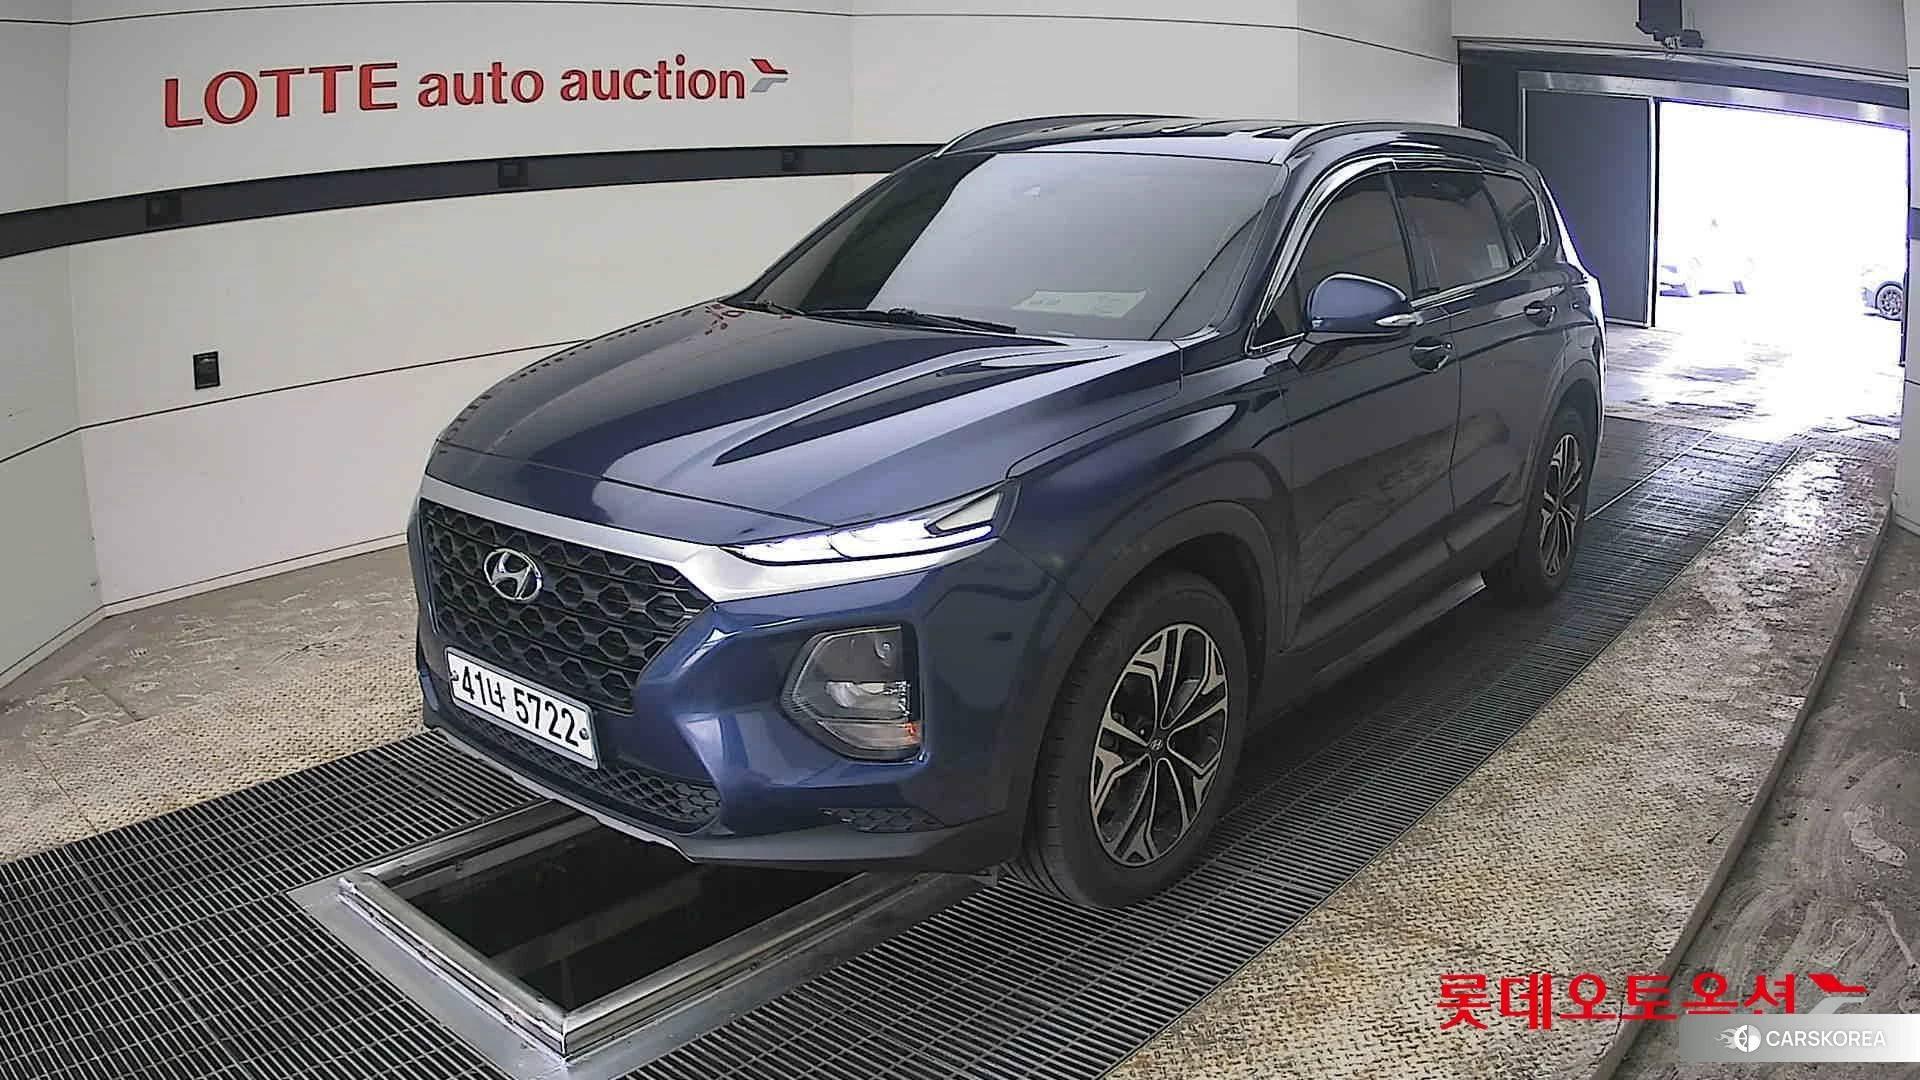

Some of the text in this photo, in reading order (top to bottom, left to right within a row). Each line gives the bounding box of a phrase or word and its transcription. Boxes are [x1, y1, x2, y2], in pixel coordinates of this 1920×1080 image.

[164, 54, 745, 128] LOTTE auto auction
[513, 687, 579, 747] 5722
